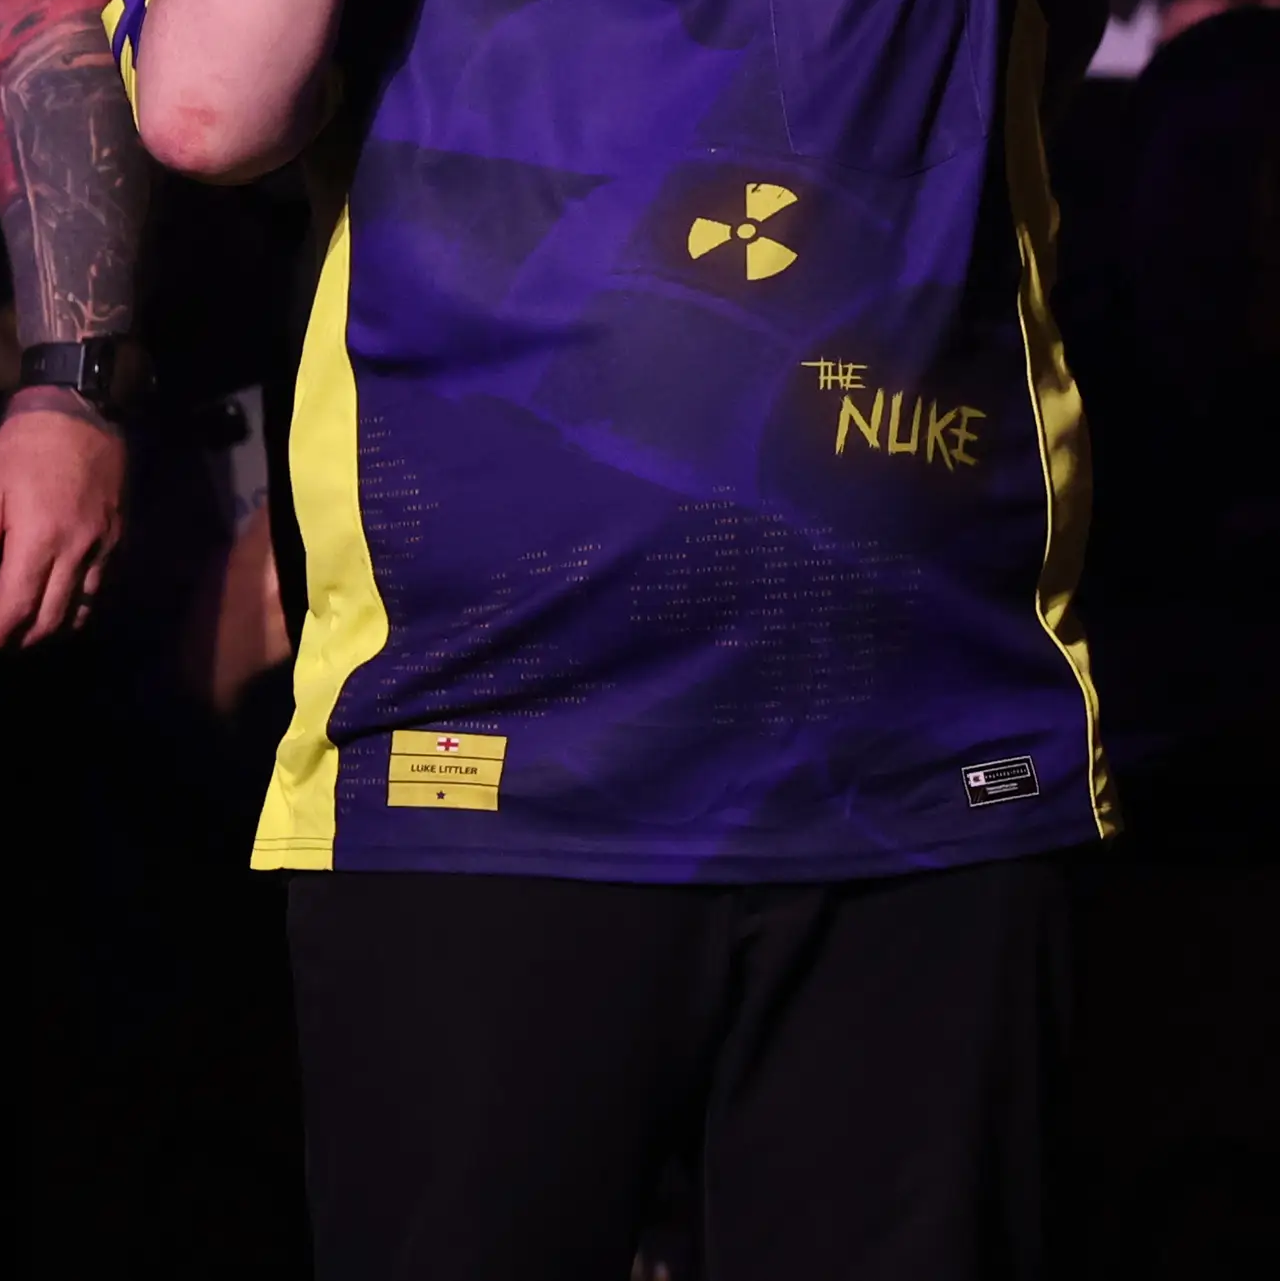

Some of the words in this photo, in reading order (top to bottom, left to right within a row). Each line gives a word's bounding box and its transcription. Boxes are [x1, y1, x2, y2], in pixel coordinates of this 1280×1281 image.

[799, 355, 869, 392] THE
[833, 387, 988, 473] NUKE
[410, 763, 437, 773] LUKE
[439, 764, 478, 775] LITTLER
